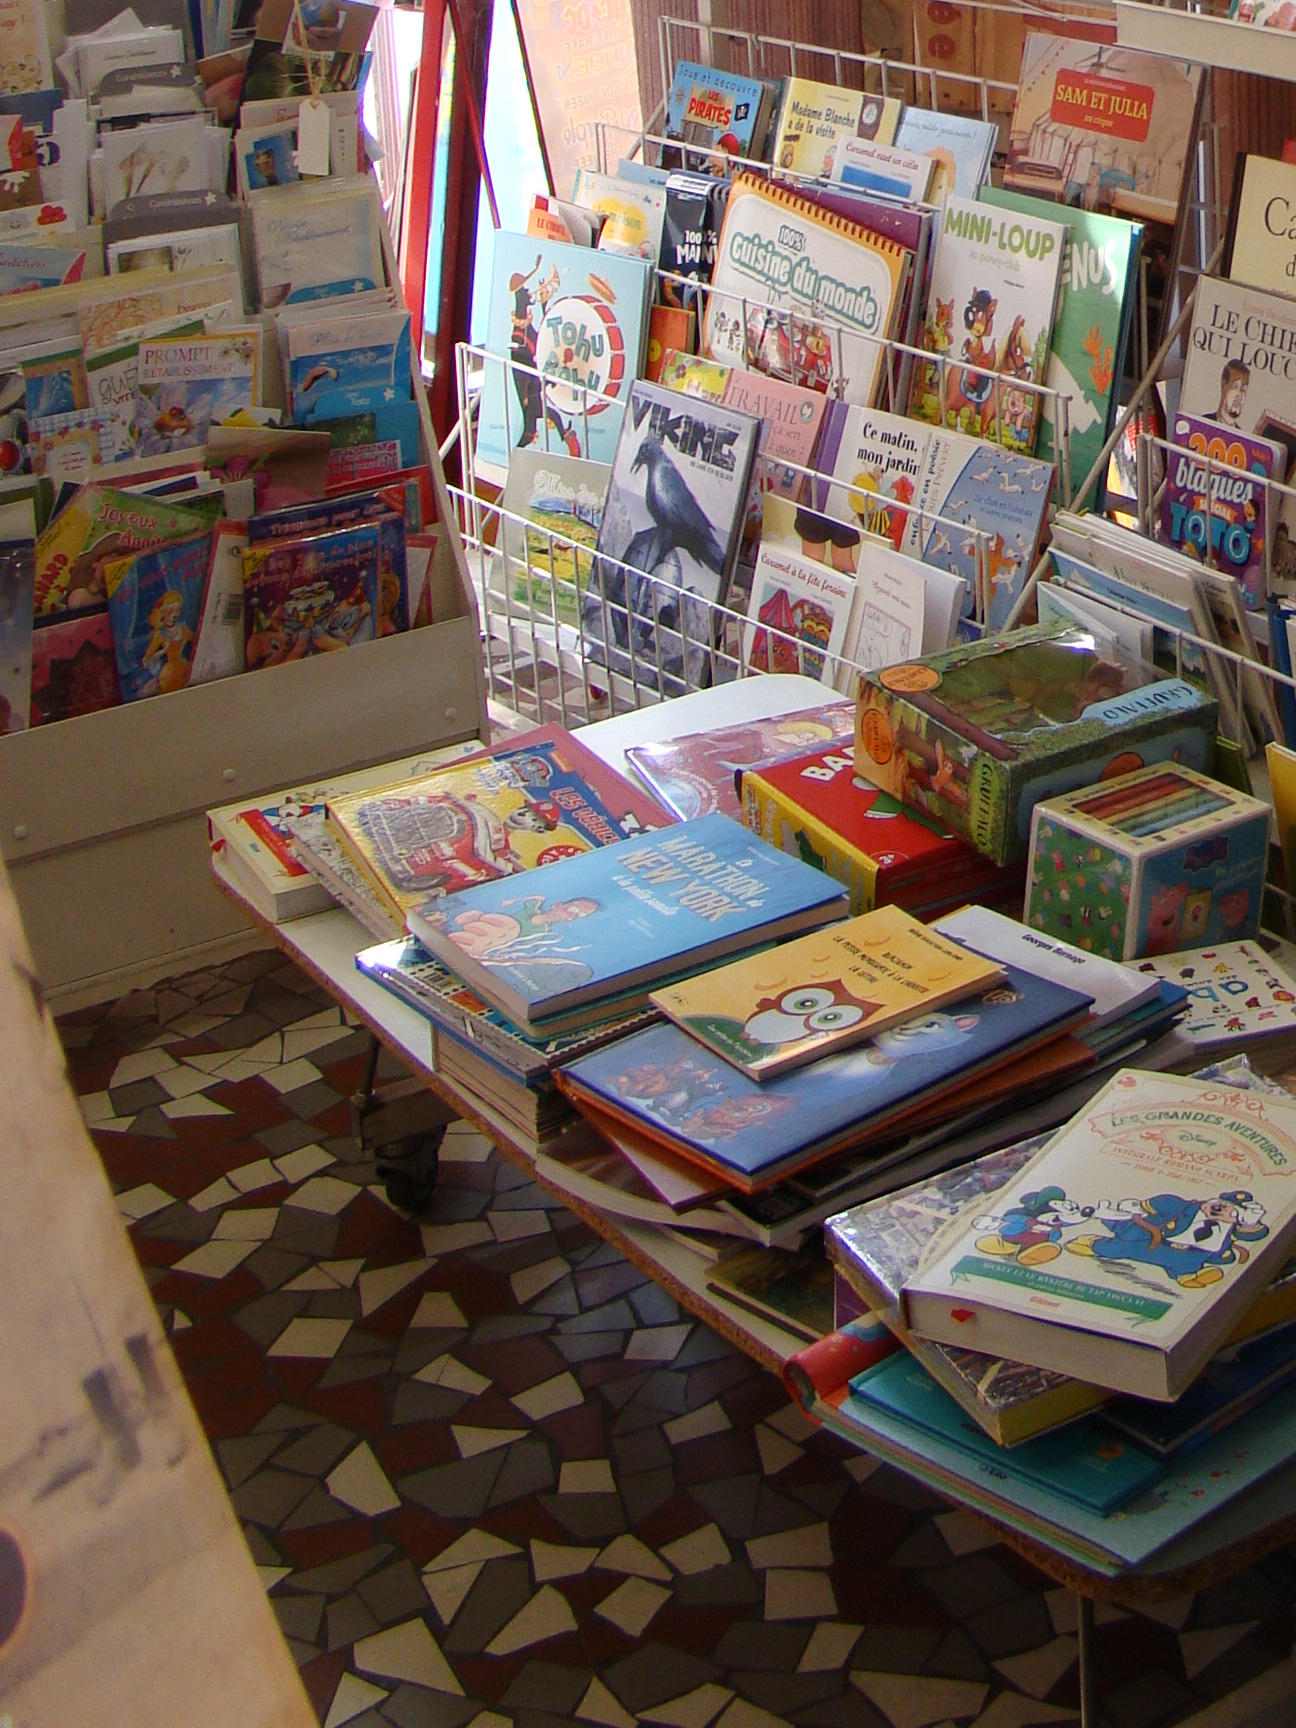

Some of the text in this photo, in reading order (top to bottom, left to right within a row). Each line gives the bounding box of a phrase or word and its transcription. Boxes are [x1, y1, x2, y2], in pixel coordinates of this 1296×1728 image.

[701, 74, 711, 84] et
[688, 97, 732, 126] PIRATES
[791, 101, 857, 130] Madame Blanche
[1056, 83, 1149, 120] SAM ET JULIA
[795, 120, 836, 140] de la visite
[778, 224, 805, 250] 100%
[944, 207, 1056, 262] MINI-LOUP
[790, 257, 818, 295] du
[818, 276, 878, 330] monde
[1209, 304, 1239, 335] LE
[546, 315, 604, 358] Tohu
[1193, 326, 1238, 359] QUI
[144, 345, 213, 366] PROMPT
[862, 421, 918, 453] Ce matin,
[856, 447, 883, 465] mon
[1174, 458, 1253, 504] blagues
[98, 501, 159, 531] Joyeux
[615, 846, 747, 924] NEW YORK
[656, 834, 770, 905] MARATHON
[1020, 933, 1053, 954] Georges
[1145, 1108, 1224, 1125] GRANDES
[1224, 1119, 1289, 1168] AVENTURES
[1177, 1129, 1218, 1147] Disney
